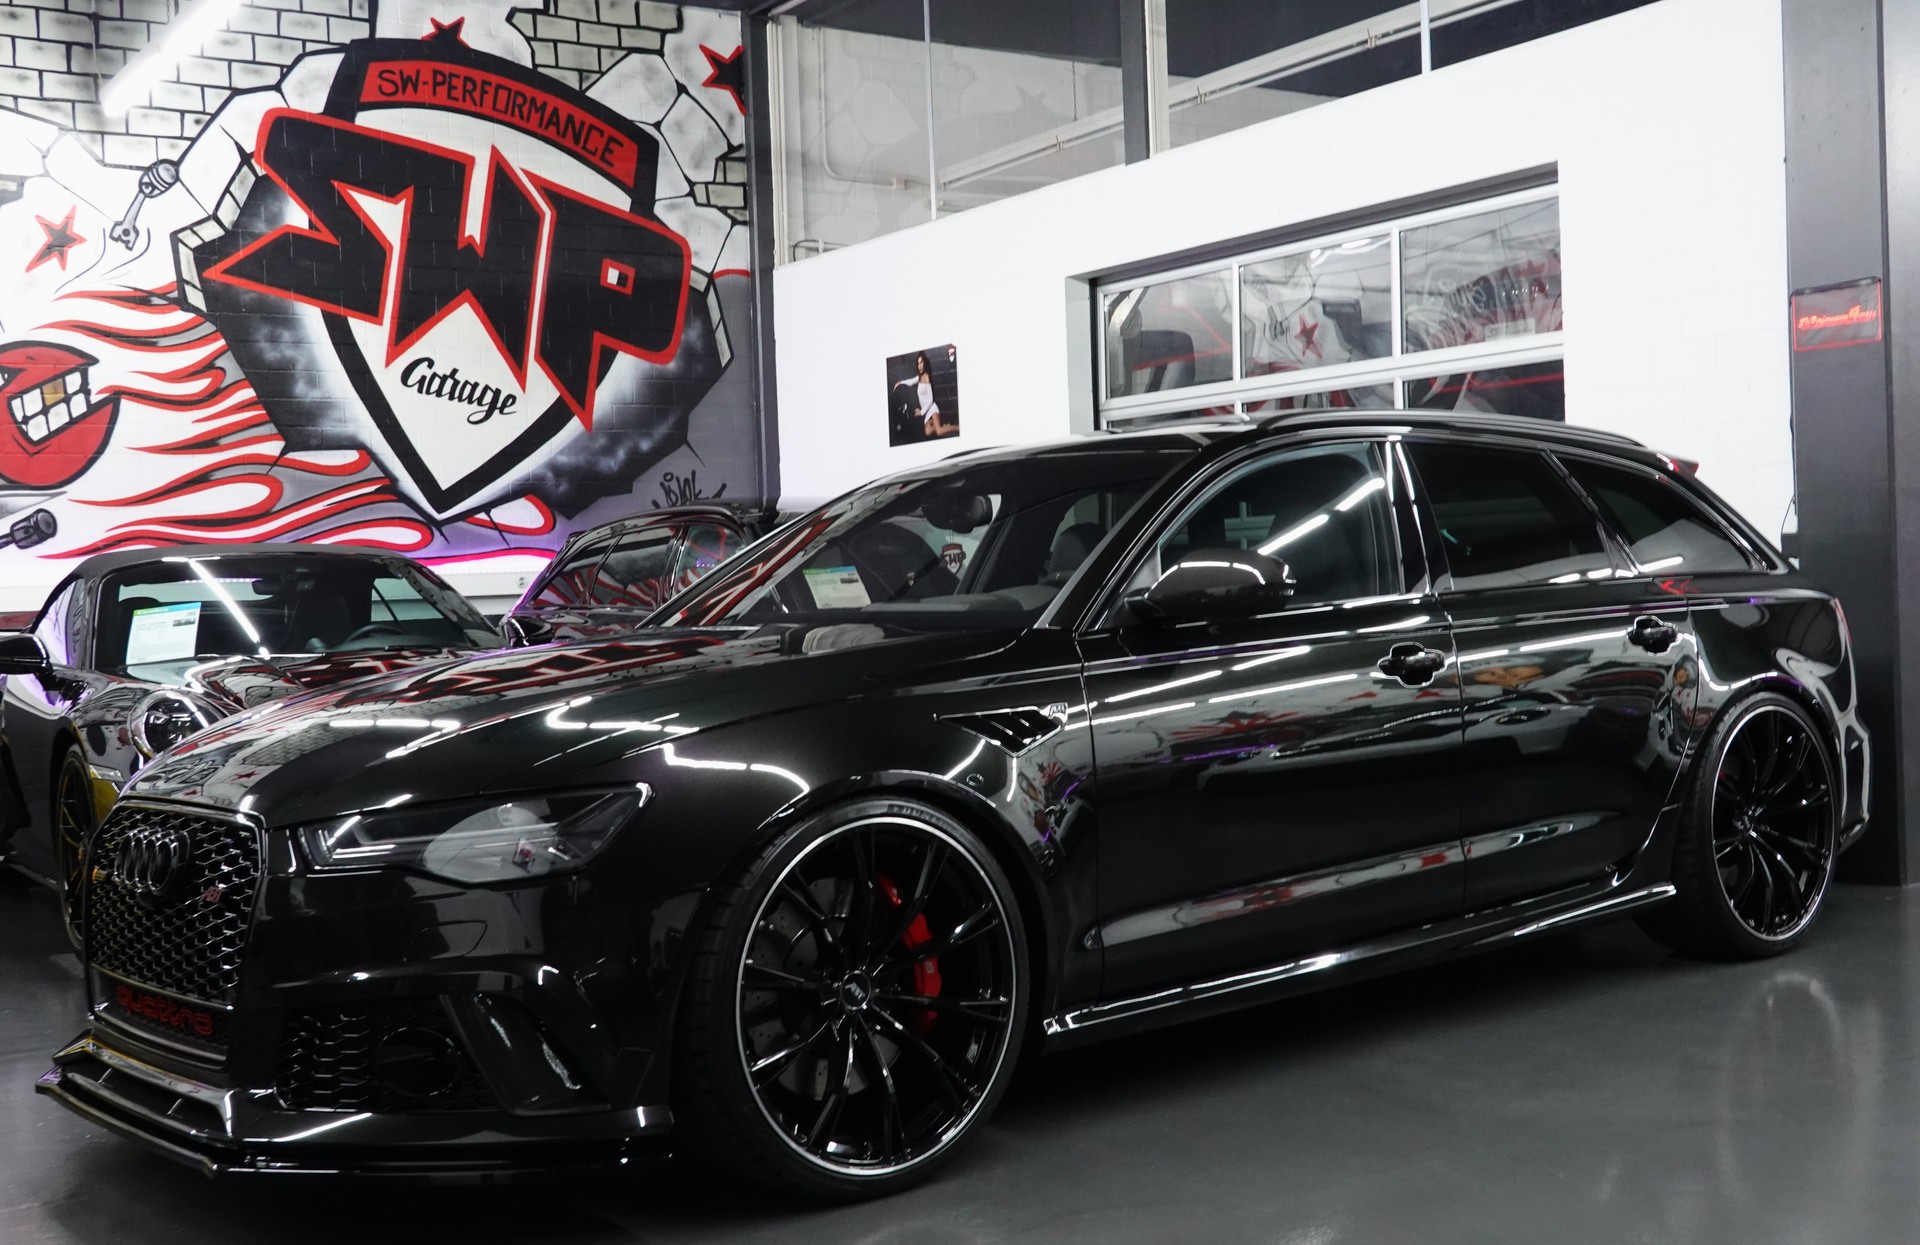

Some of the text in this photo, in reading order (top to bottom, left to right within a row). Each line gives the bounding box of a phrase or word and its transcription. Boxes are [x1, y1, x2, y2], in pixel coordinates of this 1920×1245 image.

[377, 69, 624, 168] SW-PERFORMANCE
[203, 107, 692, 433] SWP
[400, 357, 517, 425] Garage
[115, 985, 214, 1037] quattro
